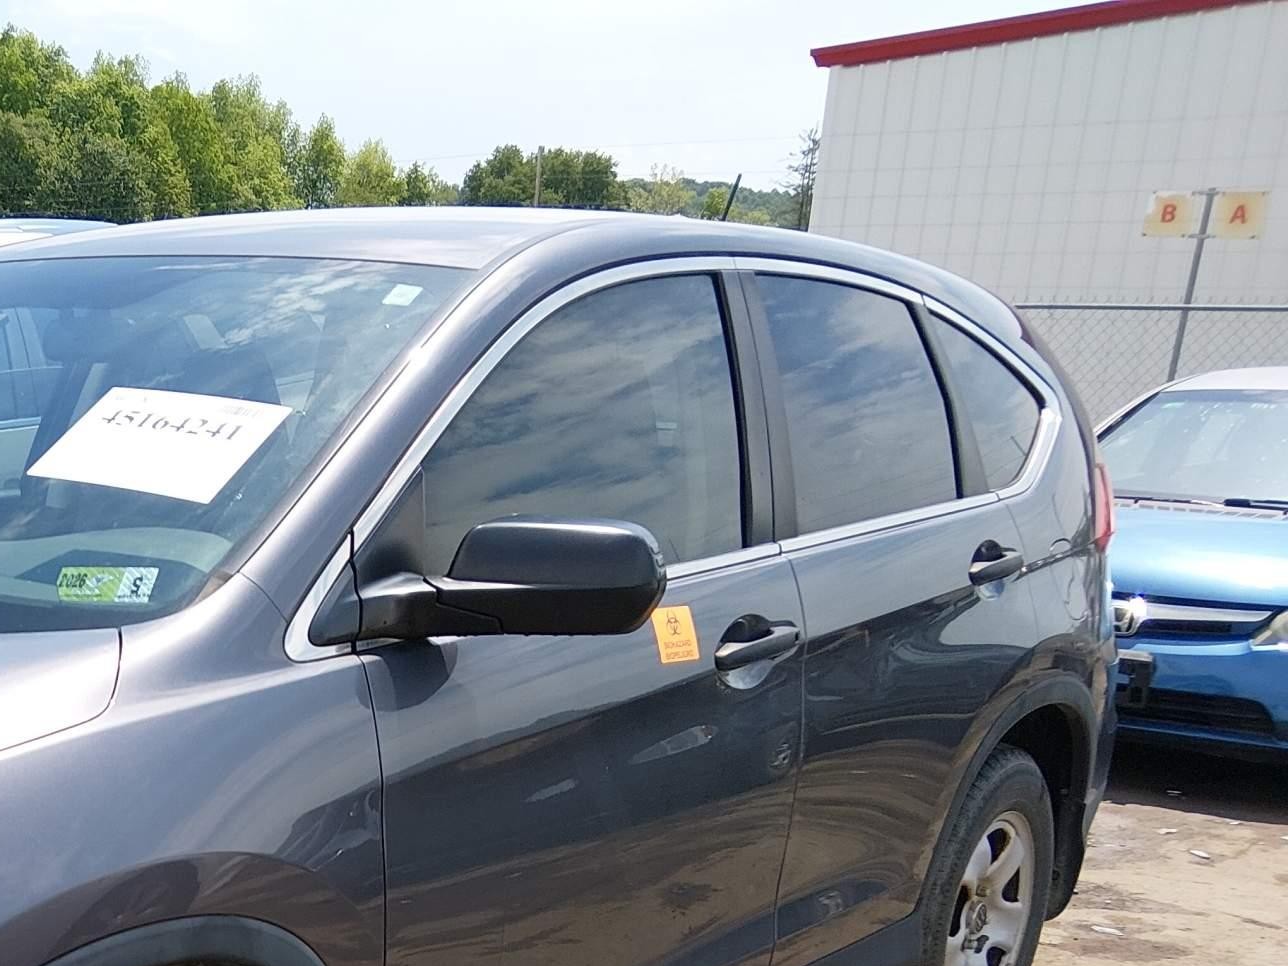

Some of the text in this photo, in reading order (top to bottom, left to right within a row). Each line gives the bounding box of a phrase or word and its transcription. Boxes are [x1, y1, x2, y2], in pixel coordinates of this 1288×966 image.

[1159, 203, 1177, 223] B
[1228, 204, 1248, 224] A
[101, 410, 243, 440] 45164241
[58, 573, 88, 589] 2026
